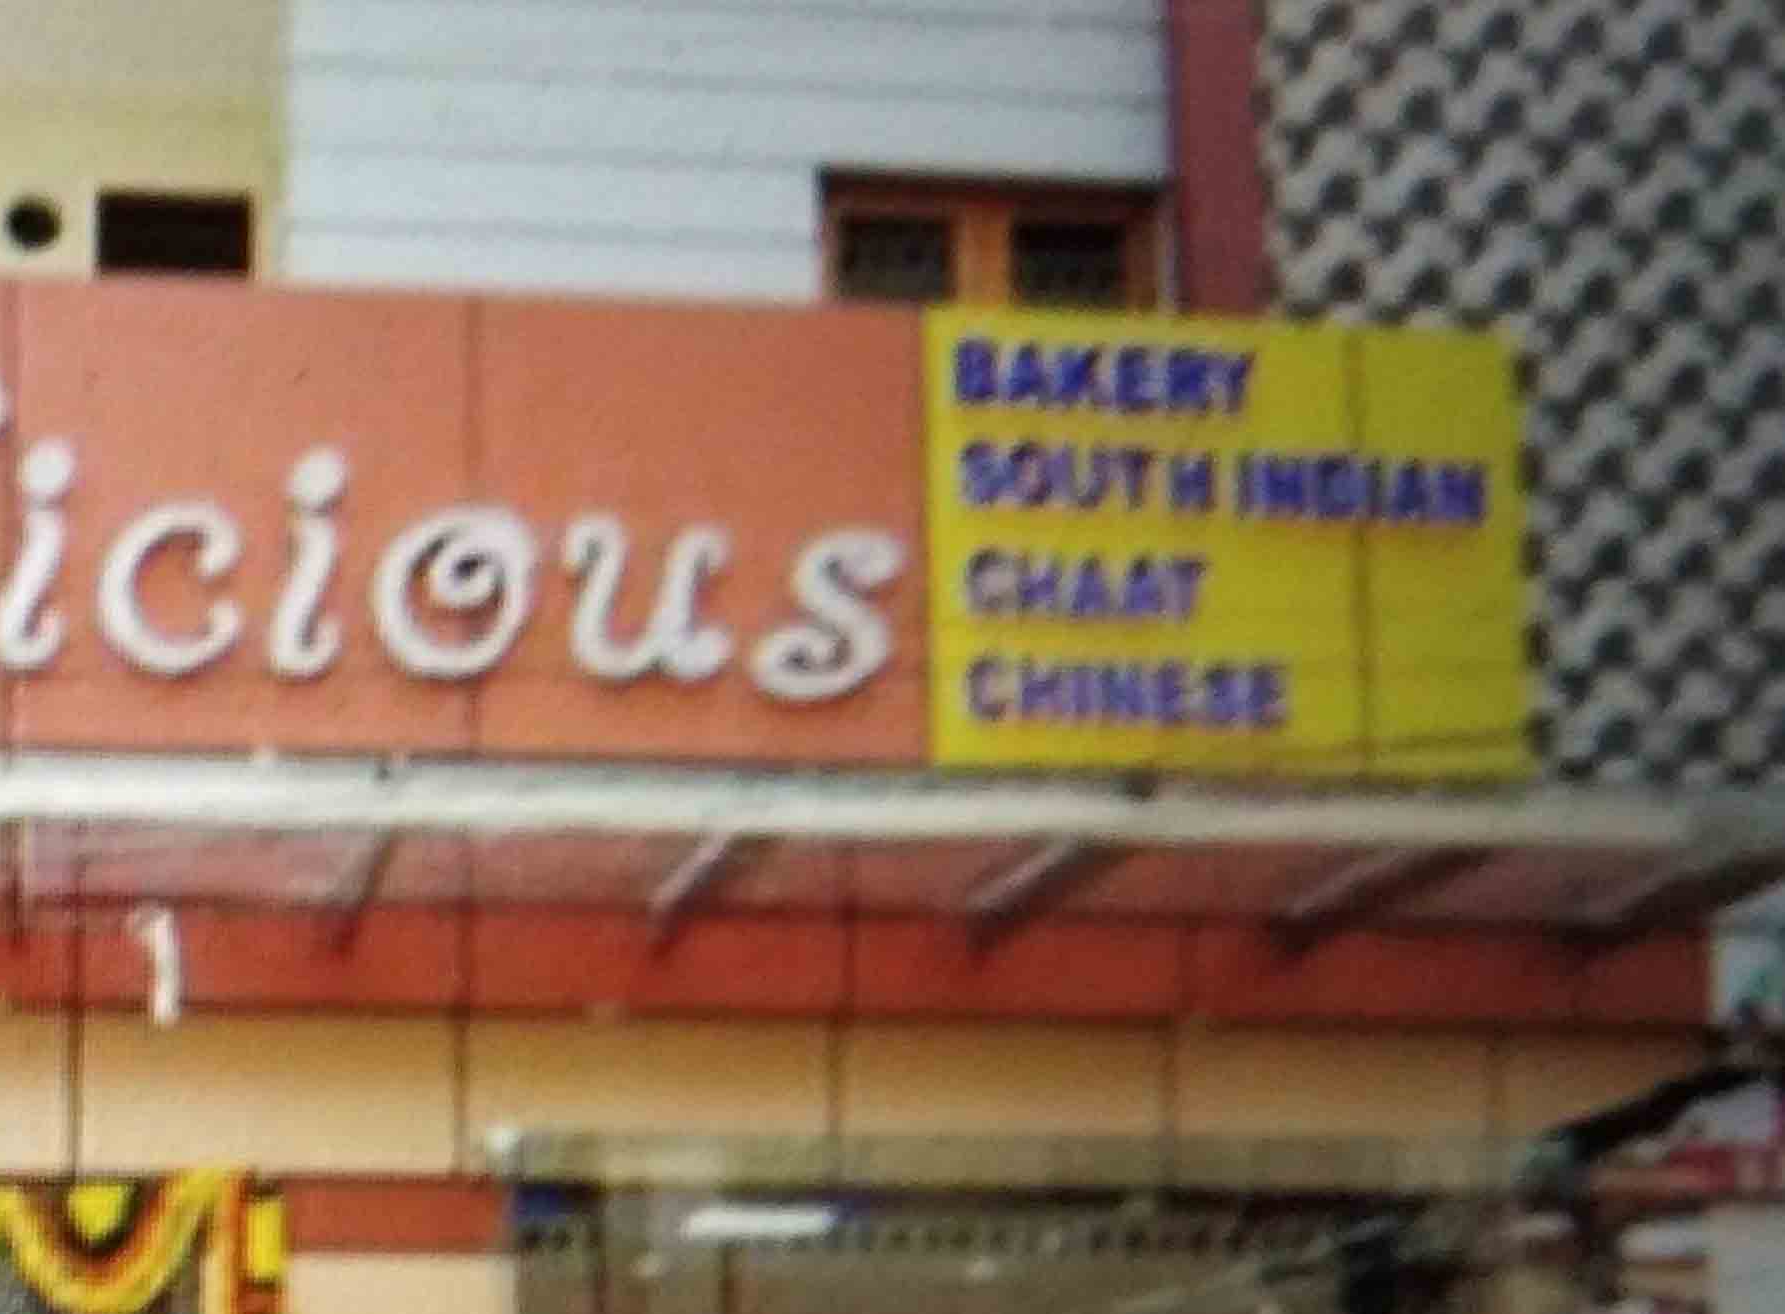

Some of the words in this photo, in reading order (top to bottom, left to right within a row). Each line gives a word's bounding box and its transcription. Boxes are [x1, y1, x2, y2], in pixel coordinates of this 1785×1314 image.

[954, 338, 1256, 414] BAKERY
[958, 440, 1216, 516] SOUTH
[1232, 450, 1487, 528] INDIAN
[964, 547, 1204, 622] CHAAT
[966, 655, 1290, 730] CHINESE
